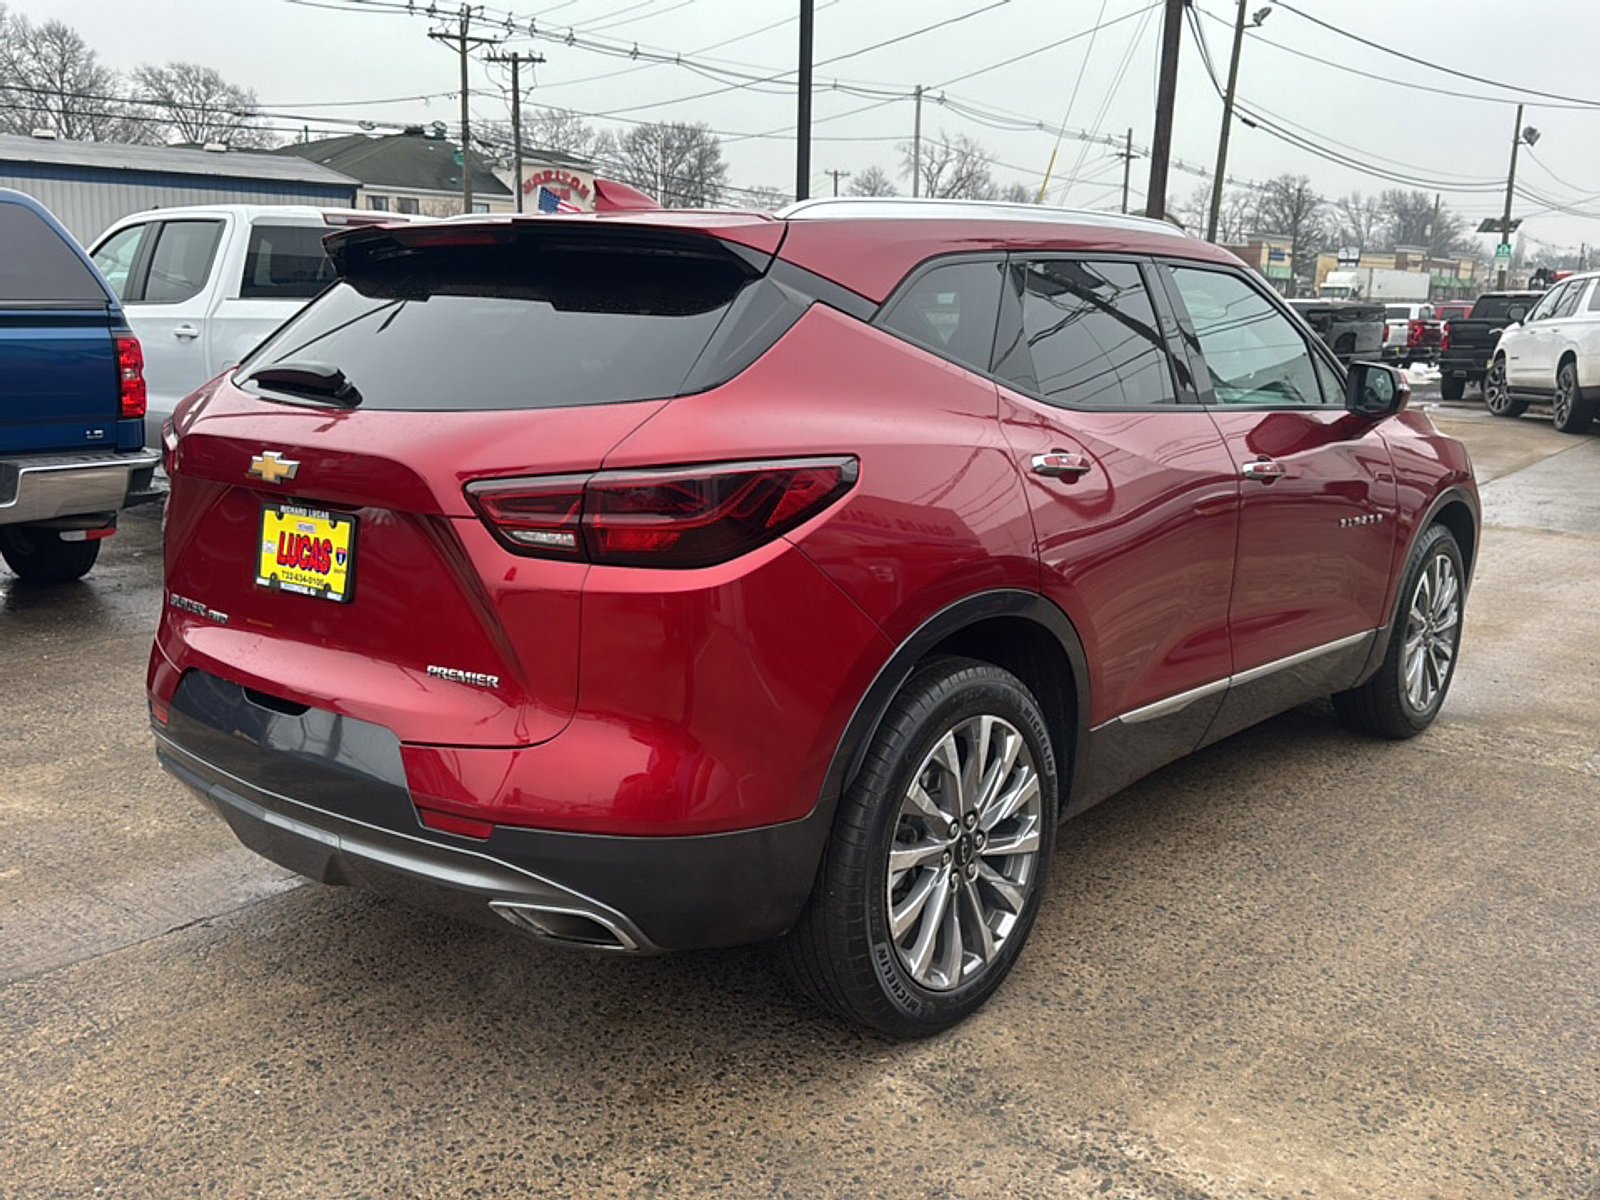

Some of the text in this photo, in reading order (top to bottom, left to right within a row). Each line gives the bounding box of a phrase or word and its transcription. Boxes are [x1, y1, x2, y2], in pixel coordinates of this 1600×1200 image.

[277, 530, 332, 576] LUCAS
[426, 664, 500, 688] PREMIER
[1023, 705, 1054, 773] MICHELIN
[875, 946, 920, 1012] MICHELIN
